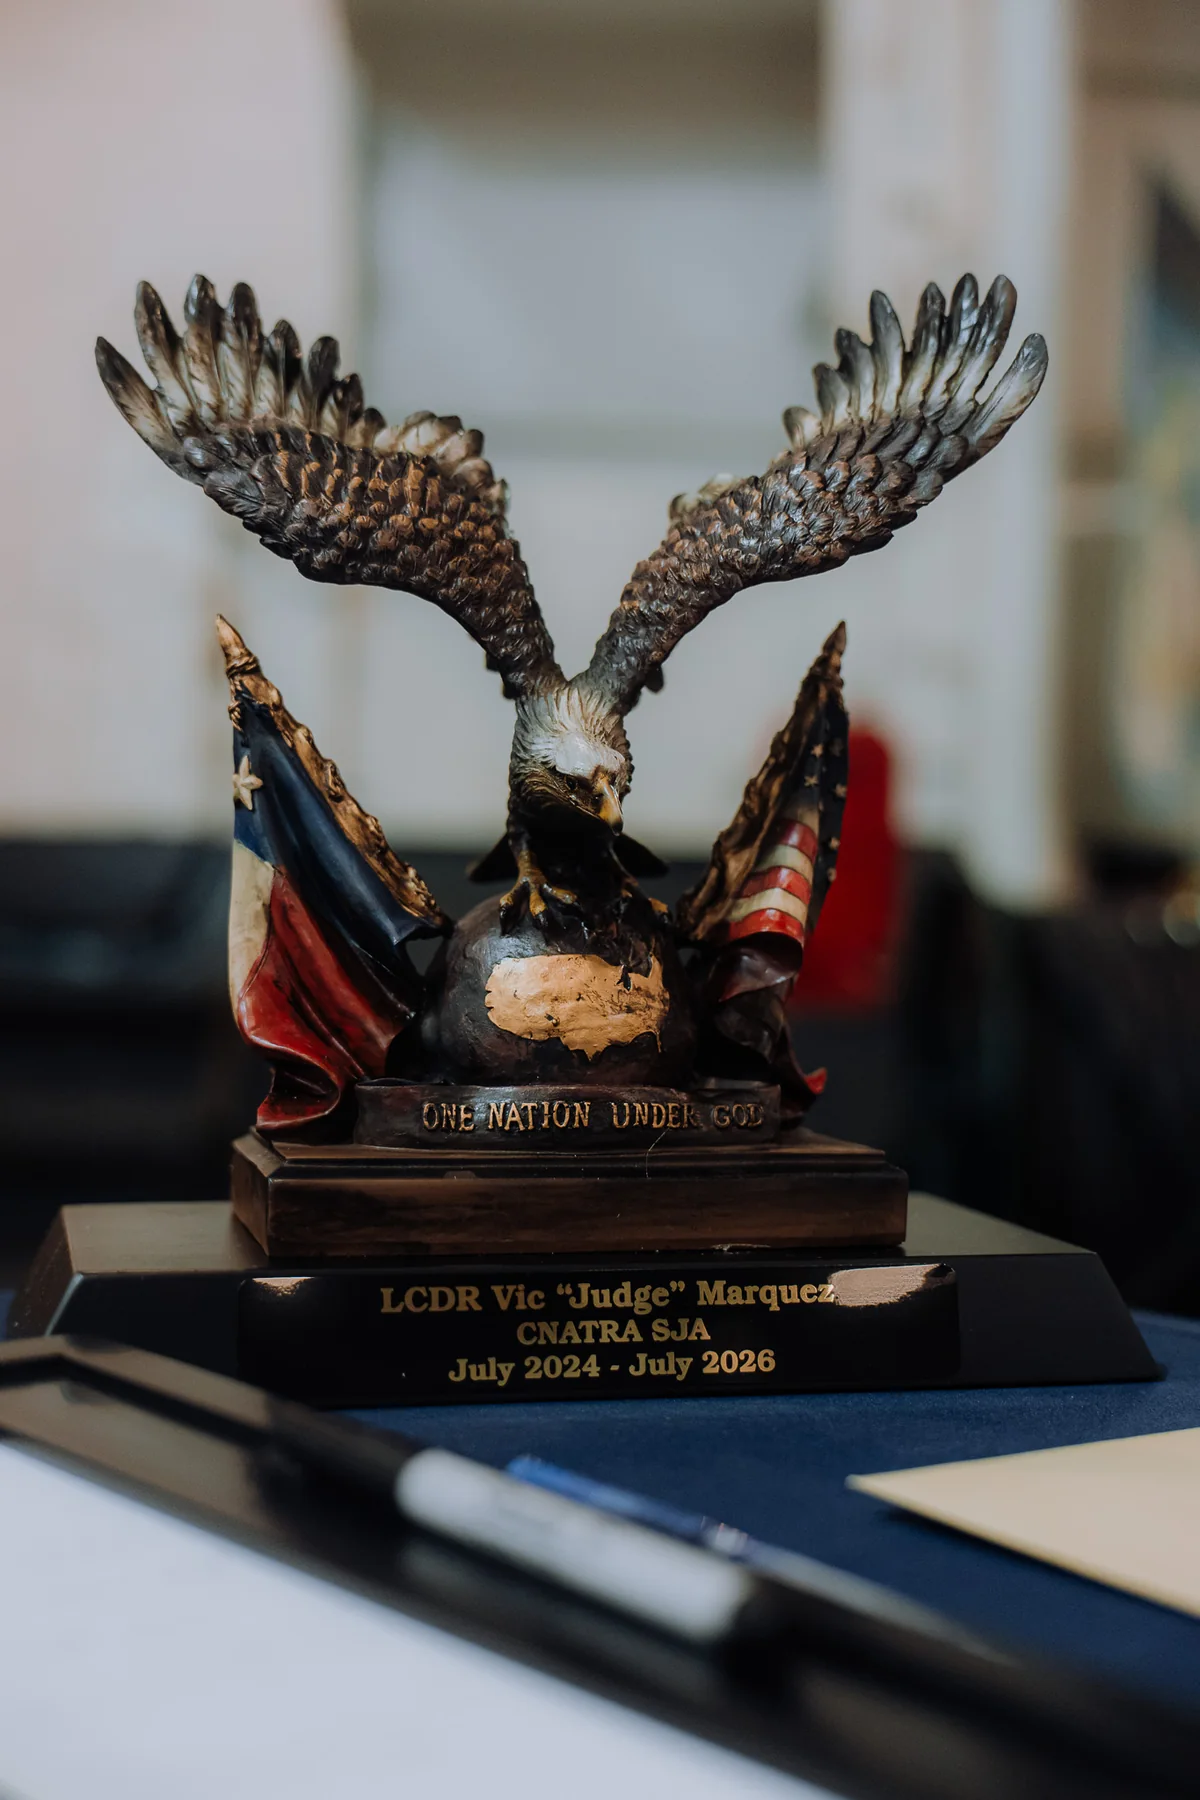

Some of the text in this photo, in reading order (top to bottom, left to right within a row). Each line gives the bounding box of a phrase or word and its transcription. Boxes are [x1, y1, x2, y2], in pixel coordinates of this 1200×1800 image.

[422, 1101, 764, 1131] ONE NATION UNDER GOD
[379, 1280, 835, 1314] LCDR Vic “Judge” Marquez
[516, 1317, 711, 1345] CNATRA SJA
[448, 1355, 516, 1386] July
[524, 1354, 600, 1379] 2024
[628, 1351, 693, 1381] July
[701, 1349, 776, 1374] 2026
